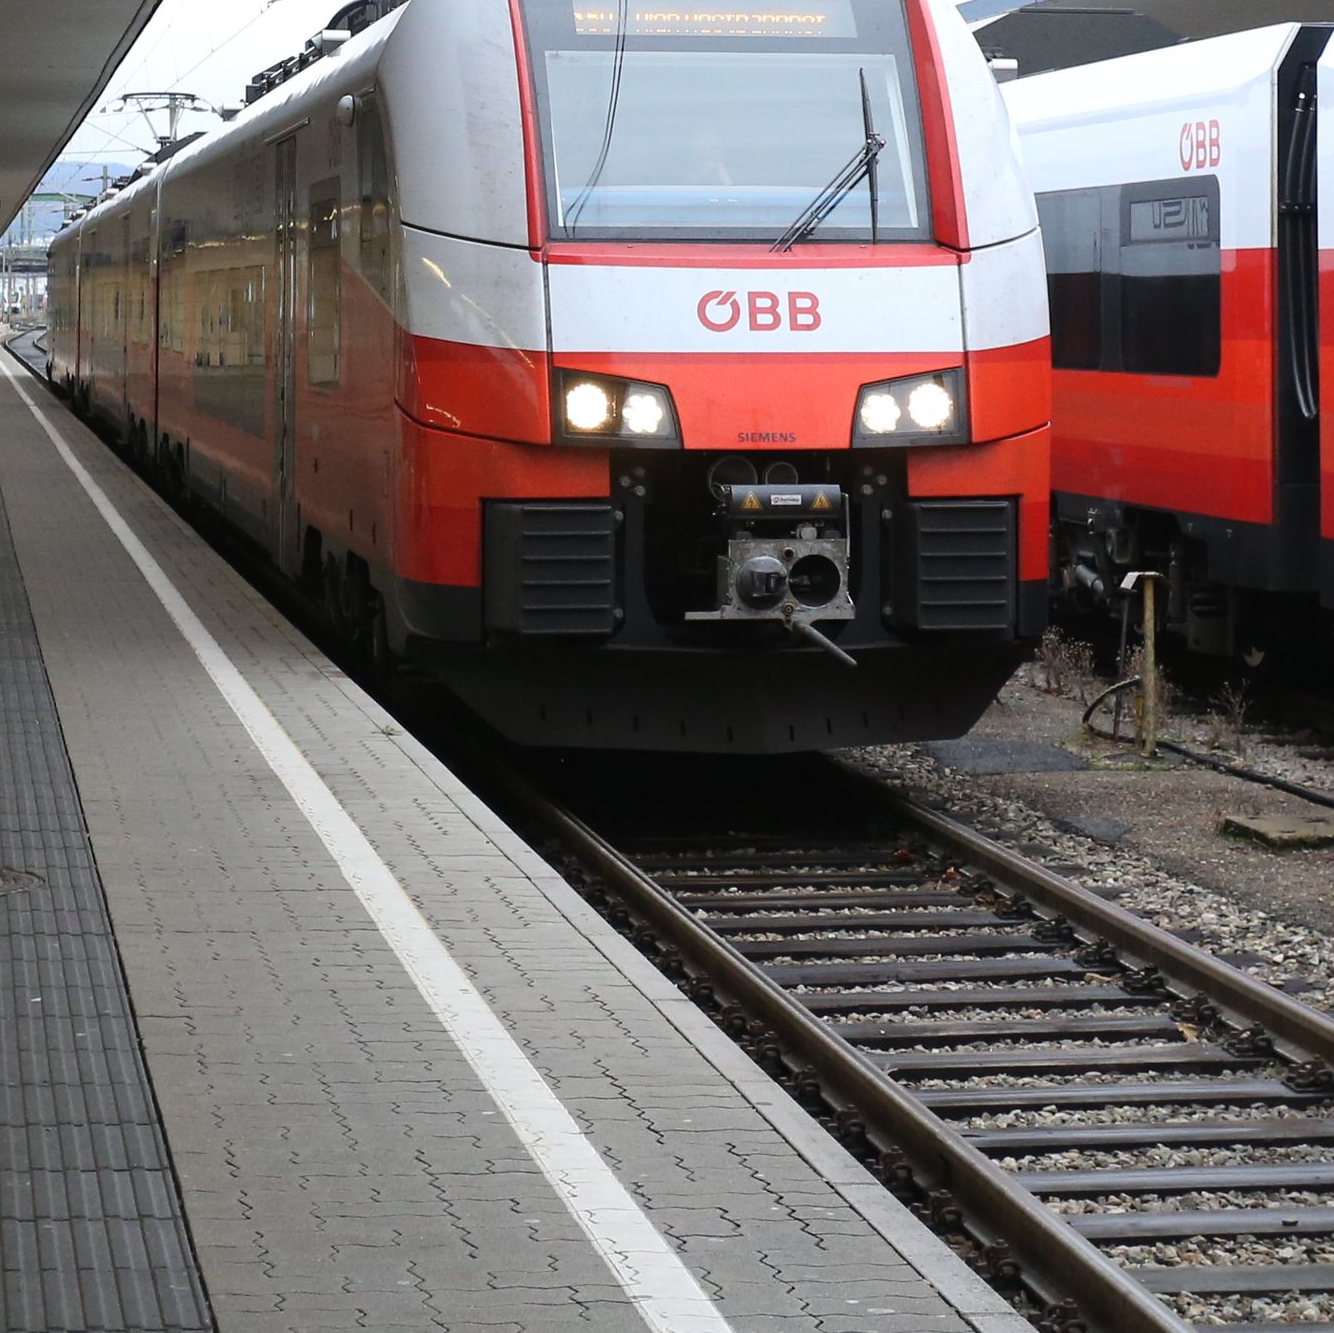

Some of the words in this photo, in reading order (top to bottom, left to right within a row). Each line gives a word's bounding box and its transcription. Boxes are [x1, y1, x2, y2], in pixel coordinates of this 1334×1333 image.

[1179, 119, 1221, 172] ÖBB
[697, 290, 822, 333] ÖBB
[738, 432, 796, 443] SIEMENS
